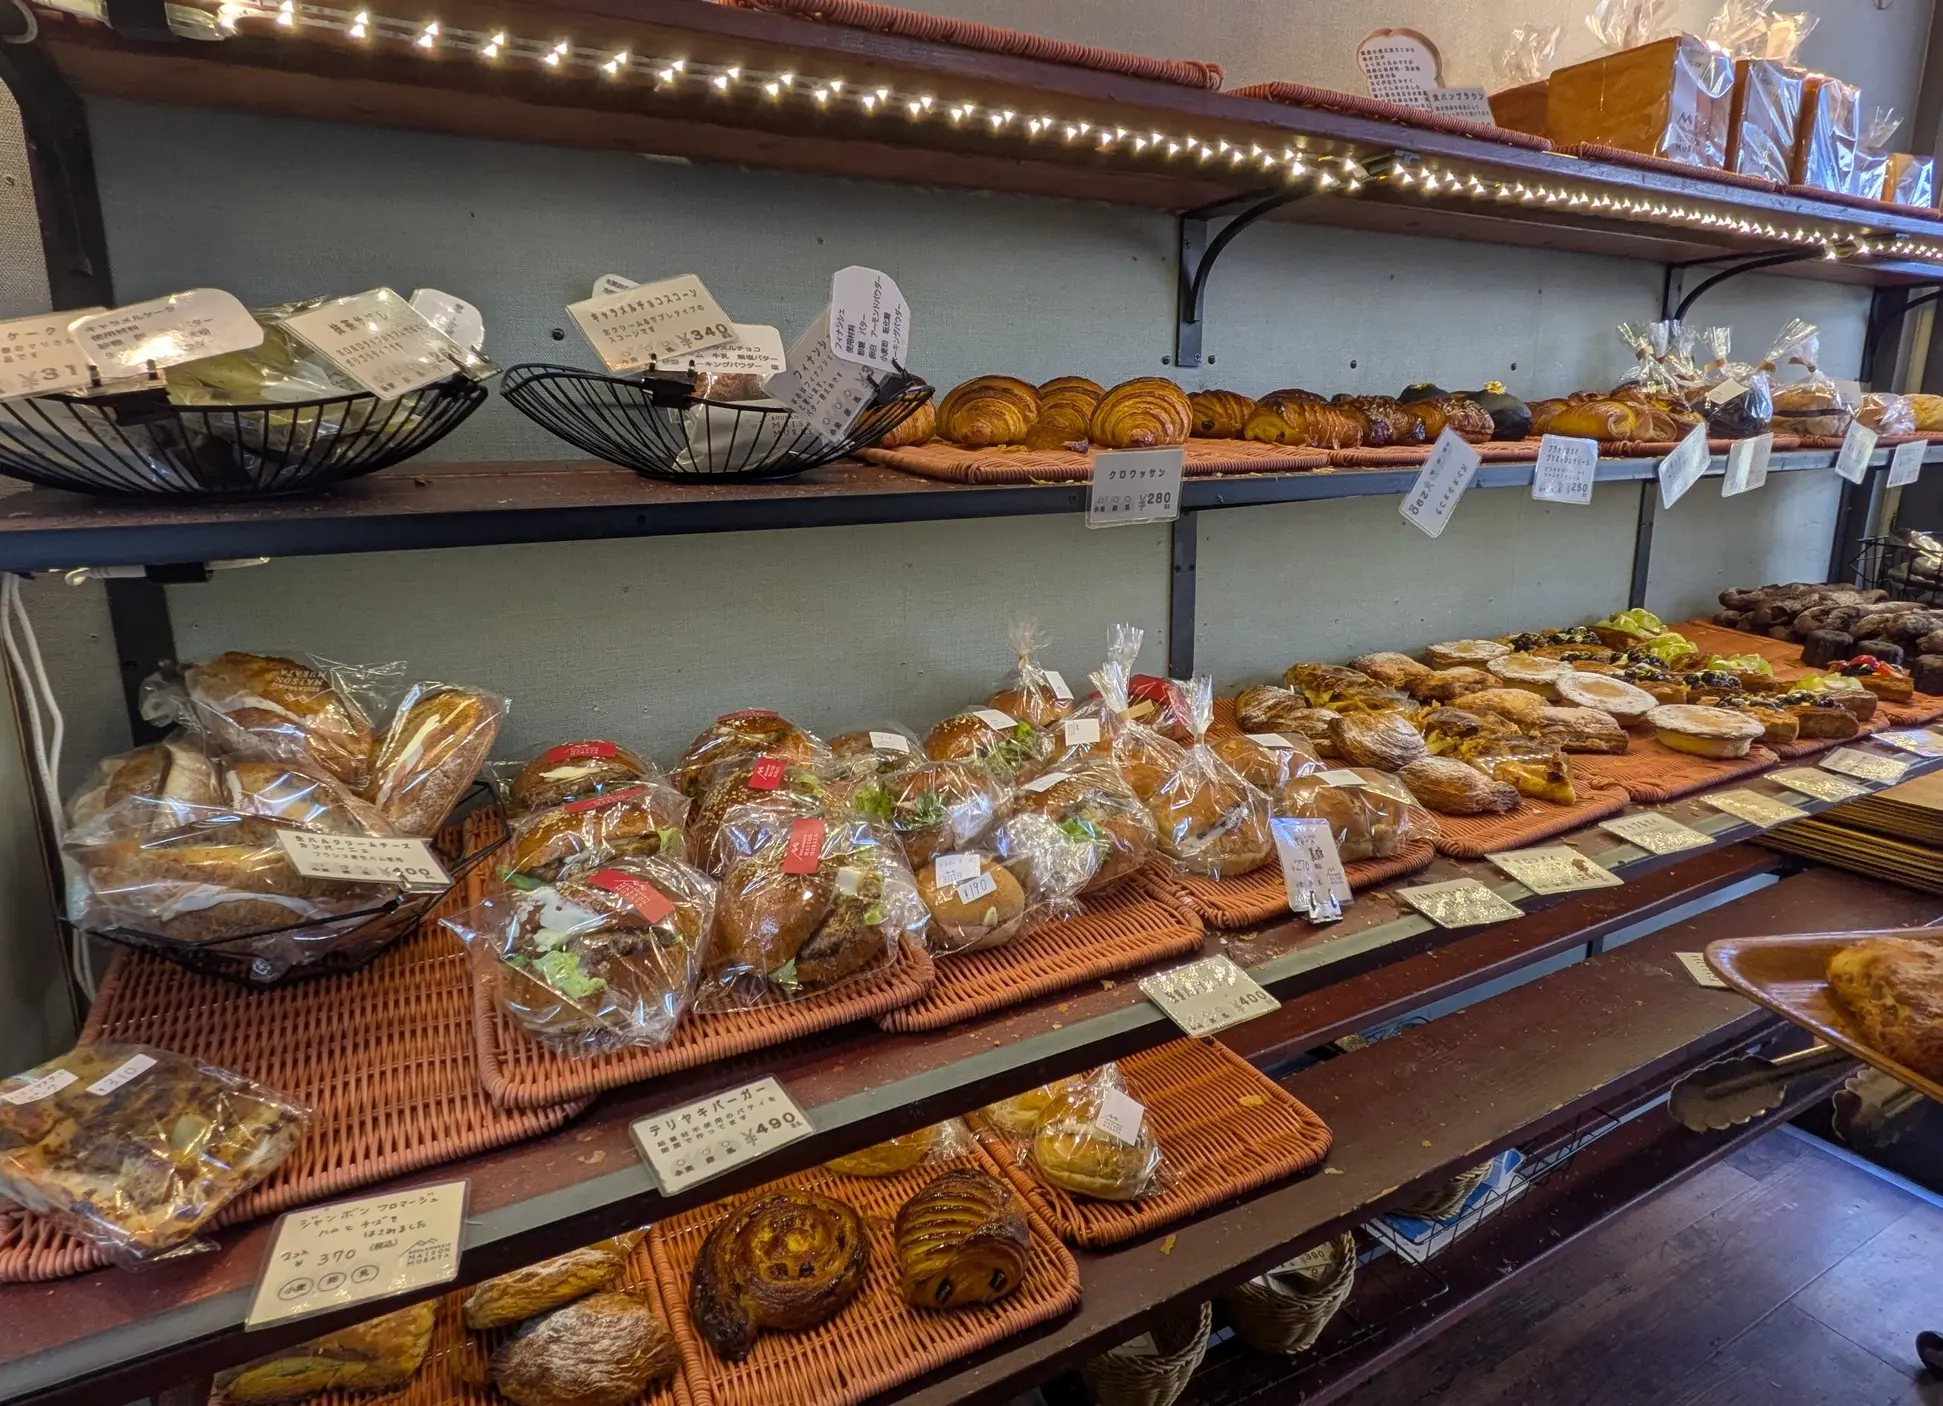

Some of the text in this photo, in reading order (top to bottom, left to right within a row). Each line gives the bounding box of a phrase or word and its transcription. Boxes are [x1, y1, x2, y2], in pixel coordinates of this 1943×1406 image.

[590, 287, 698, 323] キャラメルチョコスコーン
[834, 308, 846, 350] フィナンシェ
[793, 333, 831, 380] フィナンシ
[1109, 468, 1166, 480] クロワッサン
[1138, 491, 1172, 511] ¥280
[964, 878, 988, 900] ¥190
[649, 1085, 767, 1137] テリヤキバーガー
[740, 1111, 797, 1147] ¥490
[317, 1249, 356, 1266] 370
